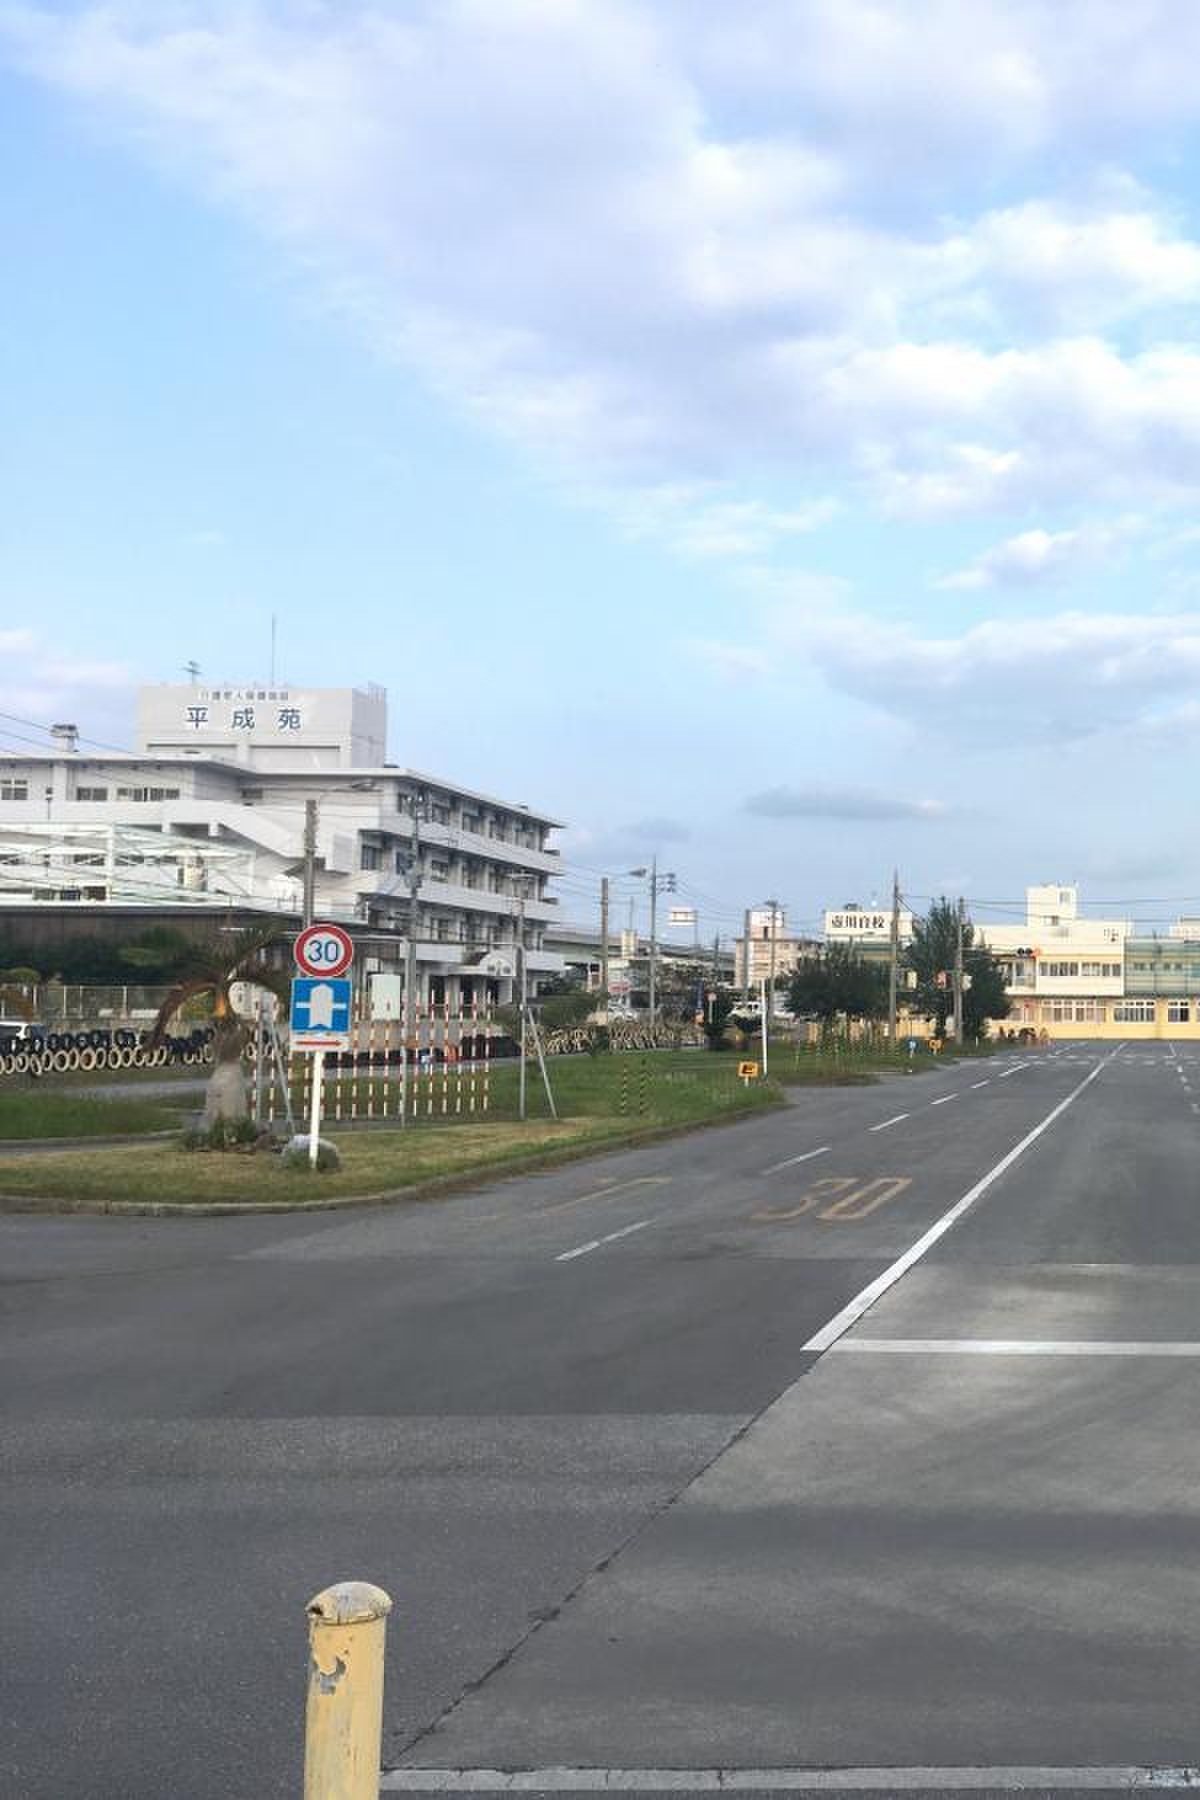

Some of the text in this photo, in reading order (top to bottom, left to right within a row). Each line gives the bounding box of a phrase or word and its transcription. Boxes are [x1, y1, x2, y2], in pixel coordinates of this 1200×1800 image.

[186, 706, 301, 729] 平成苑
[309, 940, 337, 961] 30
